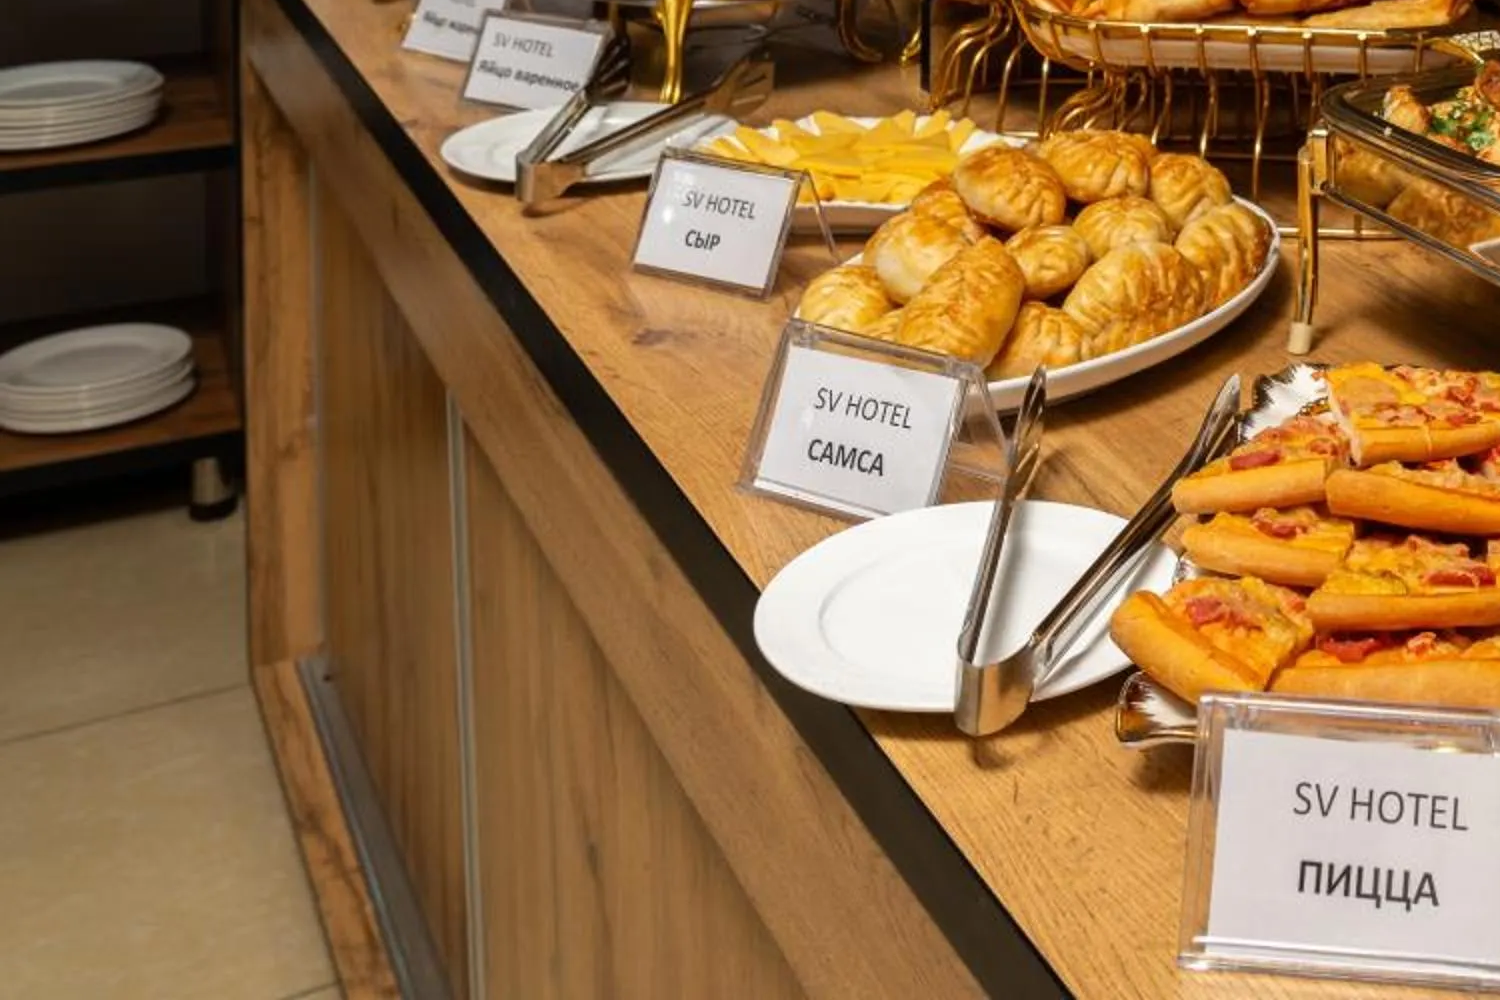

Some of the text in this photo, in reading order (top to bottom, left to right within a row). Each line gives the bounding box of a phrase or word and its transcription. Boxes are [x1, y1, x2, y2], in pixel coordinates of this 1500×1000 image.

[511, 37, 554, 58] HOTEL
[682, 190, 756, 220] SV HOTEL
[684, 229, 721, 251] СЫР
[814, 387, 912, 430] SV HOTEL
[807, 438, 884, 477] САМСА
[1293, 781, 1469, 832] SV HOTEL
[1297, 859, 1440, 913] ПИЦЦА
